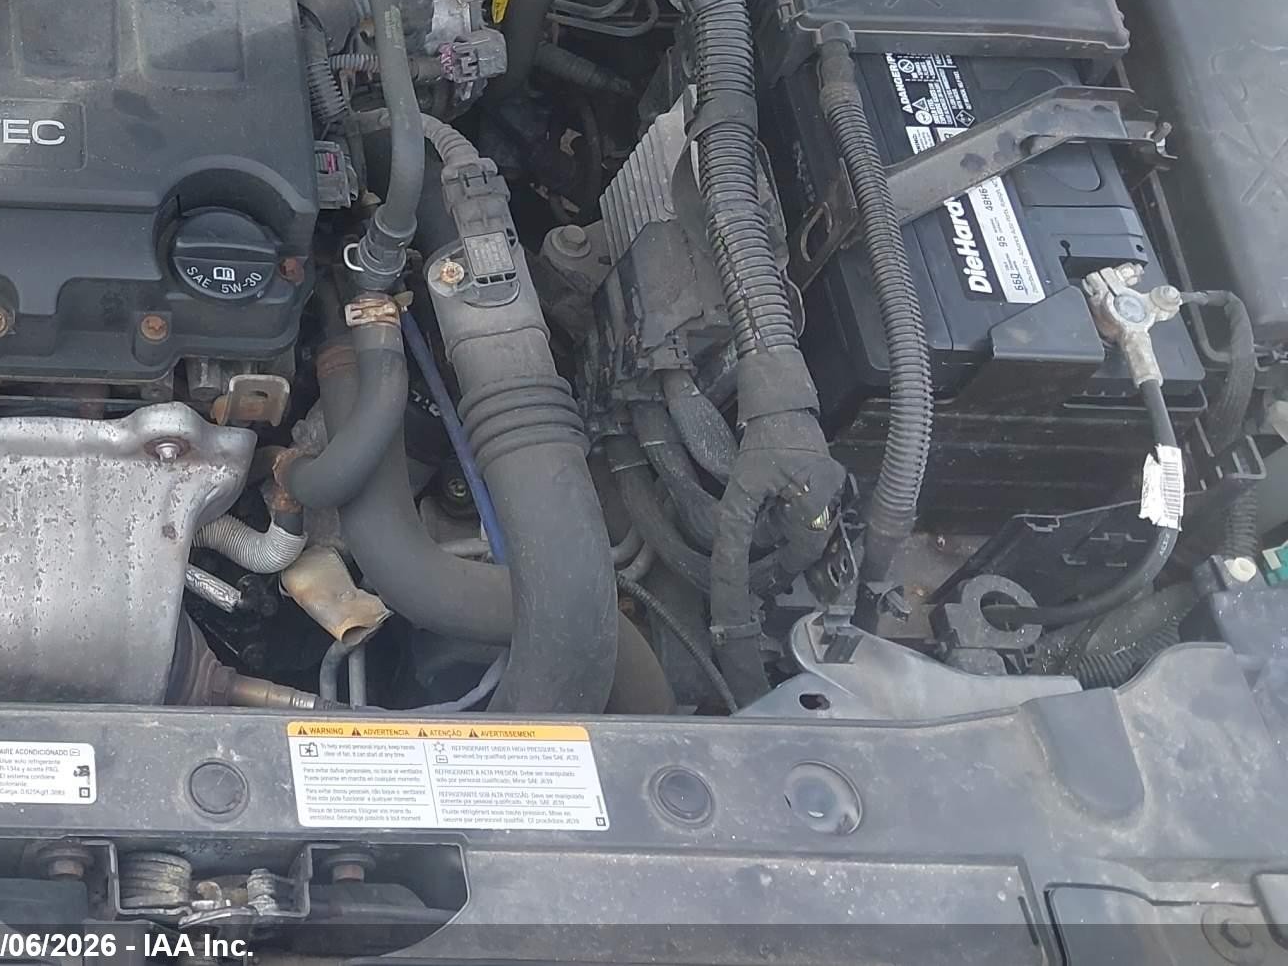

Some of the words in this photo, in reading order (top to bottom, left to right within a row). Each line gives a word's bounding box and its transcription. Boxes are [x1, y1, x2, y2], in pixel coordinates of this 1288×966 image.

[943, 196, 993, 294] DieHard
[187, 266, 212, 288] SAE
[221, 272, 262, 293] 5W-30
[430, 729, 462, 738] ATENÇÃO
